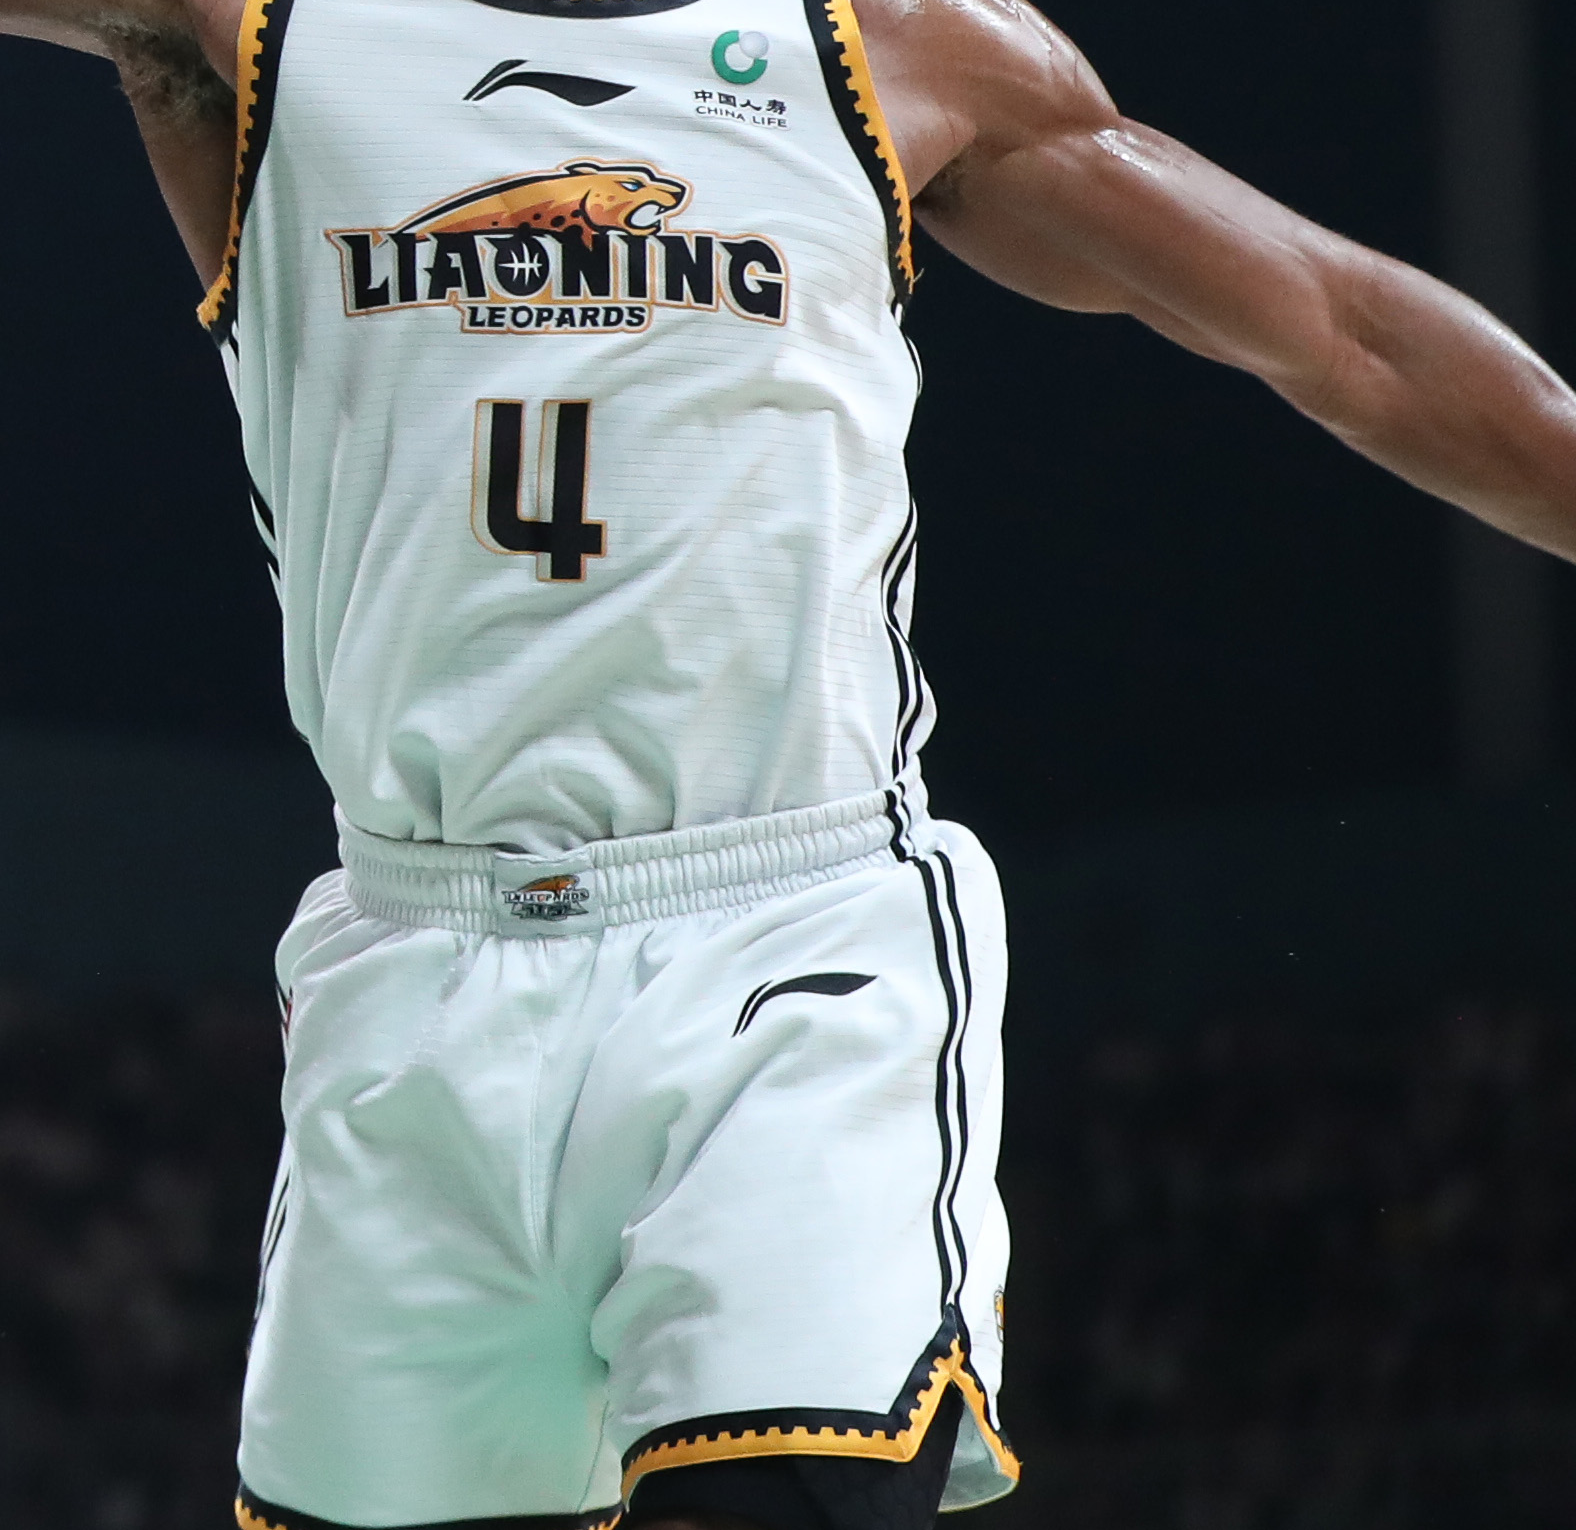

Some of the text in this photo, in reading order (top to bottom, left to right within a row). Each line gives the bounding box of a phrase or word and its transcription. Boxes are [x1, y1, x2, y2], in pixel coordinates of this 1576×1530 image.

[694, 90, 787, 115] 中国人寿
[696, 106, 788, 128] CHINA LIFE
[333, 230, 786, 321] LIAONING
[466, 304, 647, 330] LEOPARDS
[473, 400, 605, 581] 4
